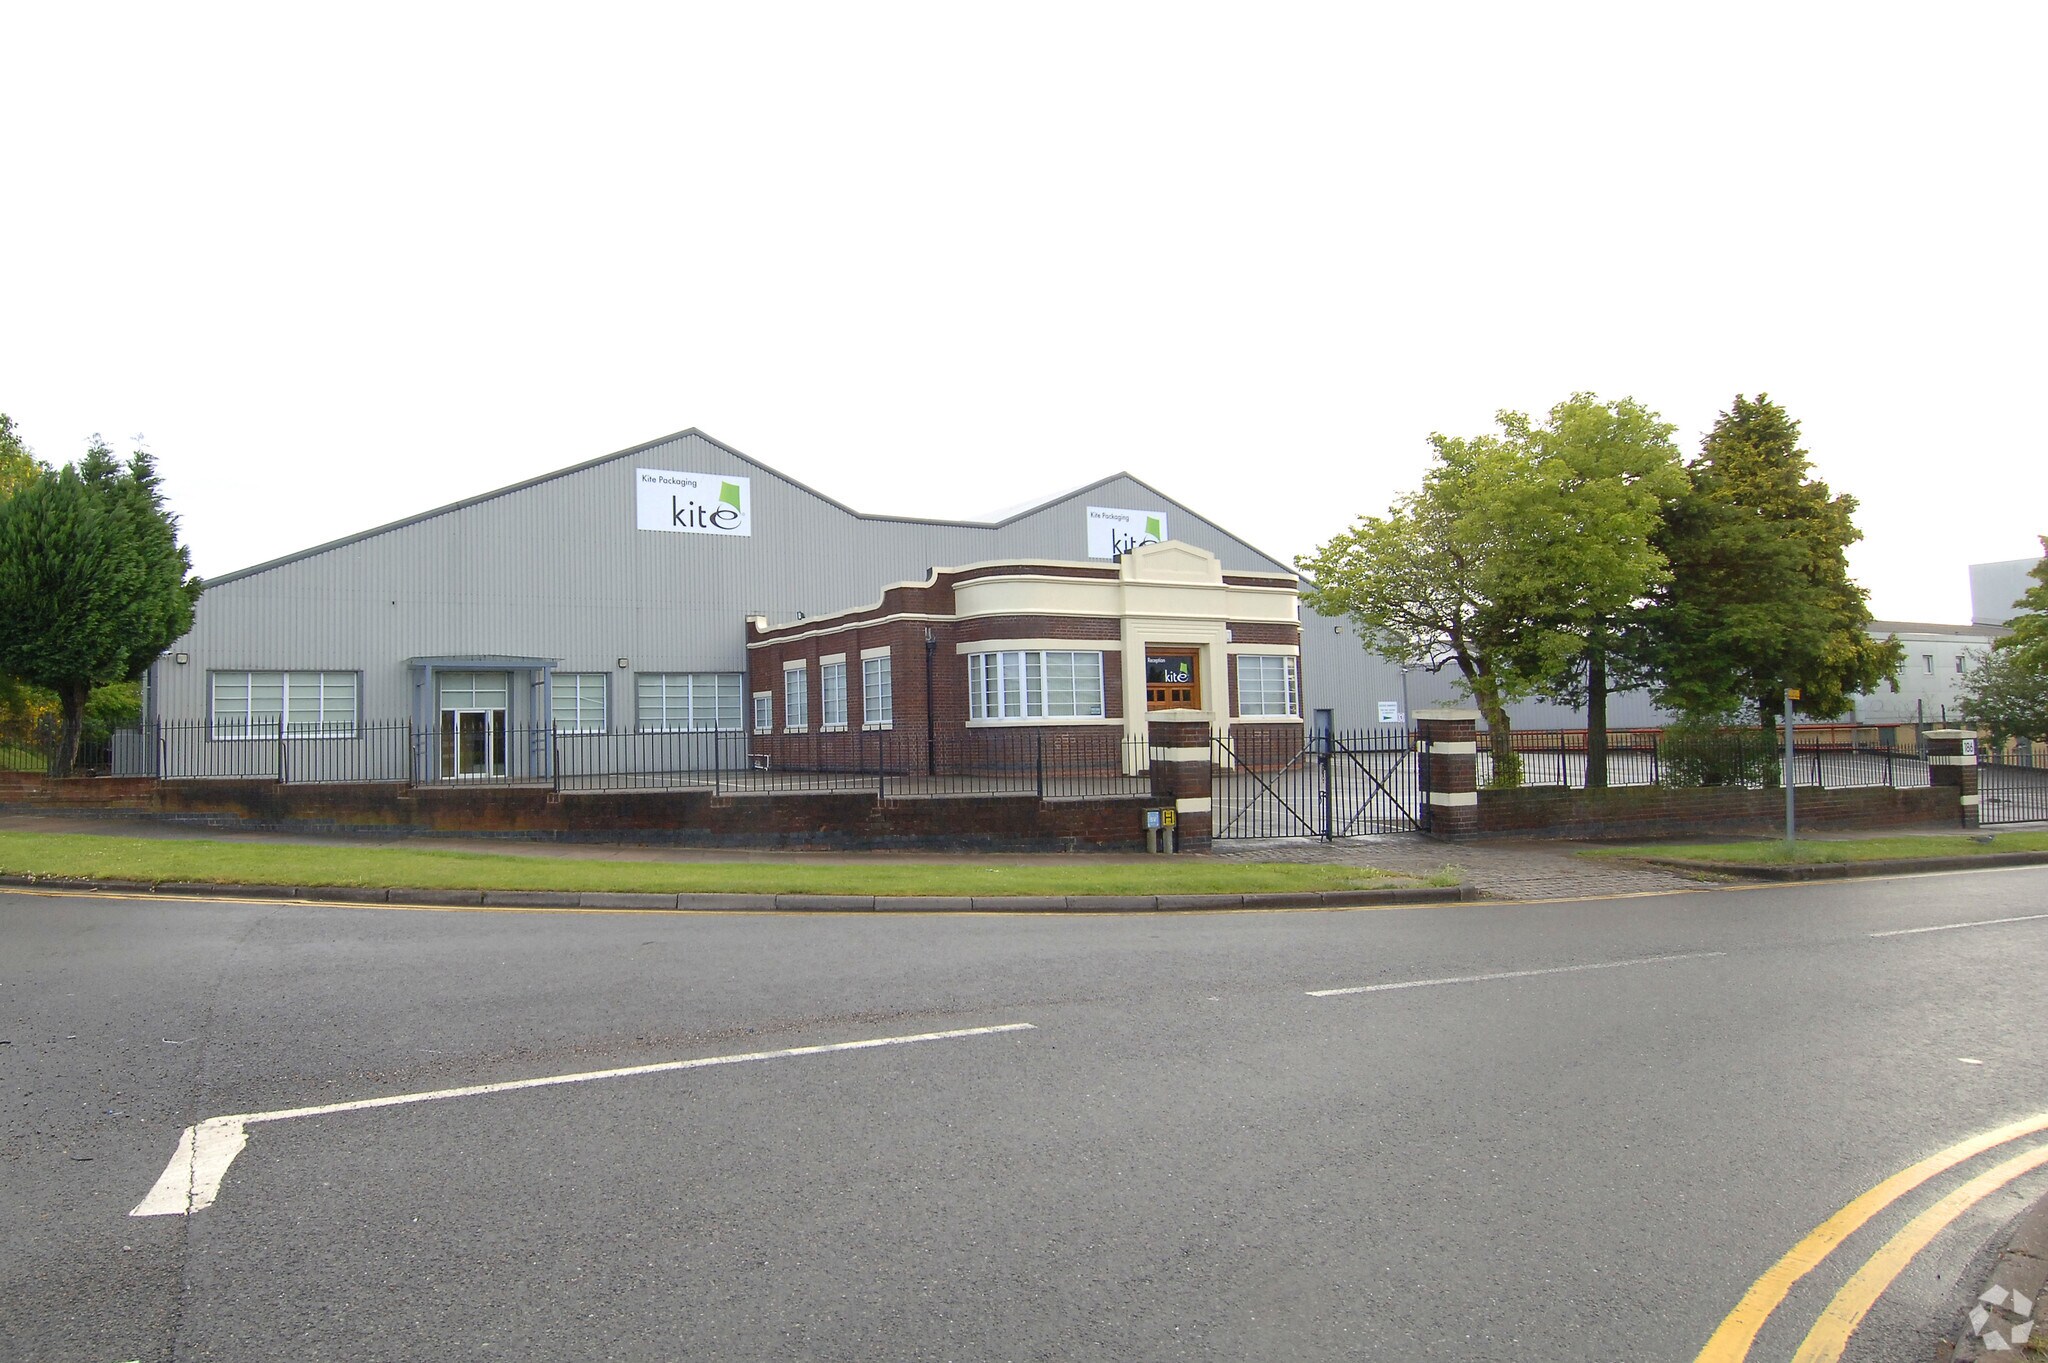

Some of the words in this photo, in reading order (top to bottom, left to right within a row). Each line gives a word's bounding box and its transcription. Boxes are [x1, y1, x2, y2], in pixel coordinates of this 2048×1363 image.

[642, 474, 656, 483] Kite
[659, 476, 697, 488] Packaging
[672, 495, 742, 530] kite
[1102, 512, 1129, 522] Packaging
[1164, 669, 1189, 682] kite
[1164, 811, 1173, 824] H
